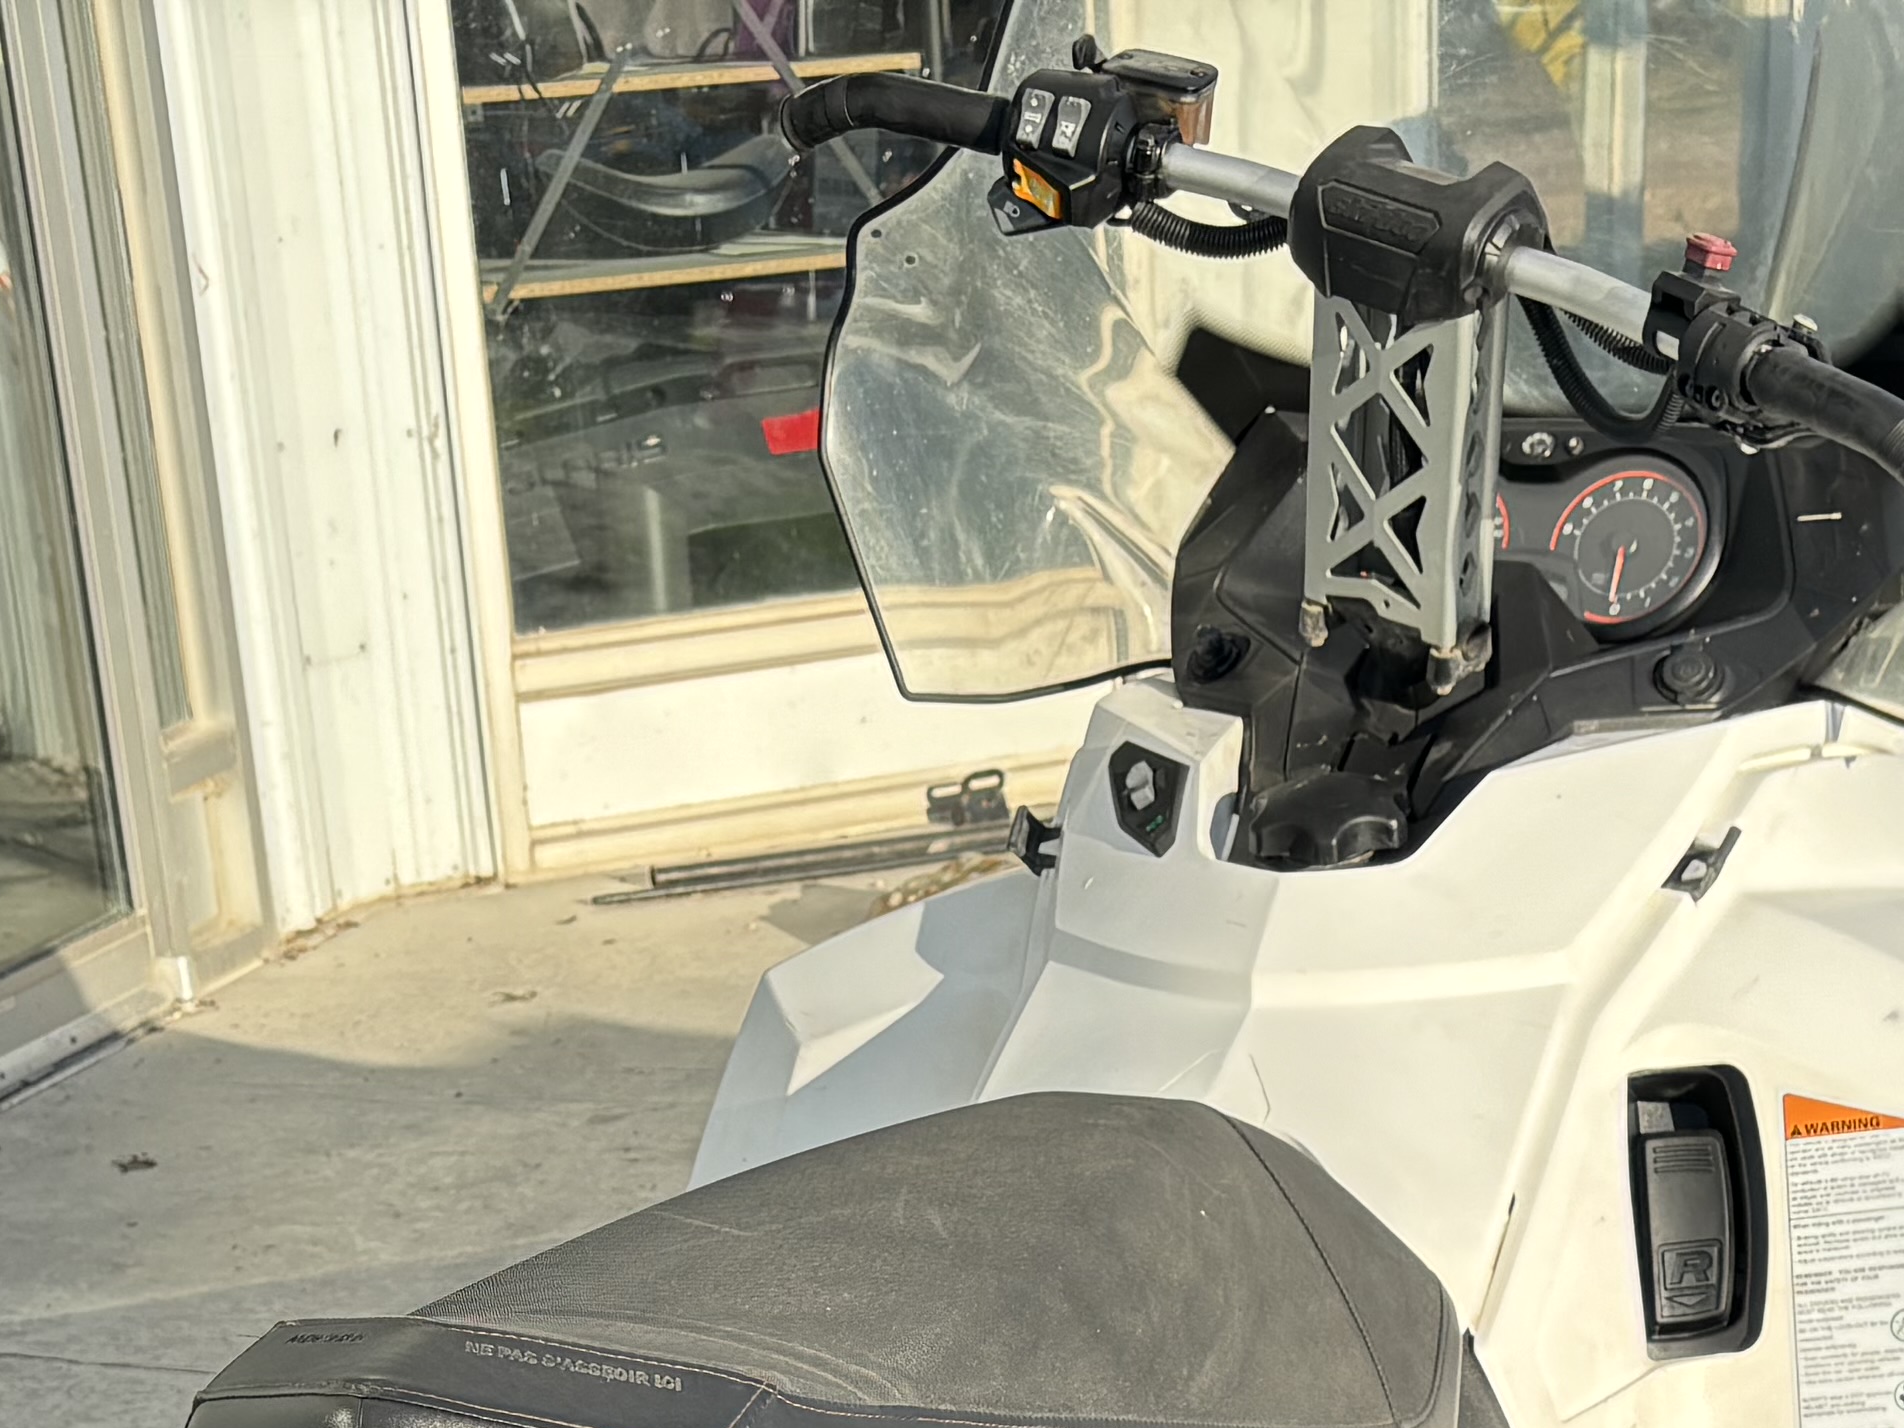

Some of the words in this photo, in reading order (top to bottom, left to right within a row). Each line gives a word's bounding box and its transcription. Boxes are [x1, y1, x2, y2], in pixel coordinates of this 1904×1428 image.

[1804, 1115, 1881, 1136] WARNING
[465, 1340, 495, 1357] NE
[498, 1345, 538, 1365] PAS
[541, 1354, 651, 1387] S'ASSEOIR
[654, 1373, 682, 1392] ICI
